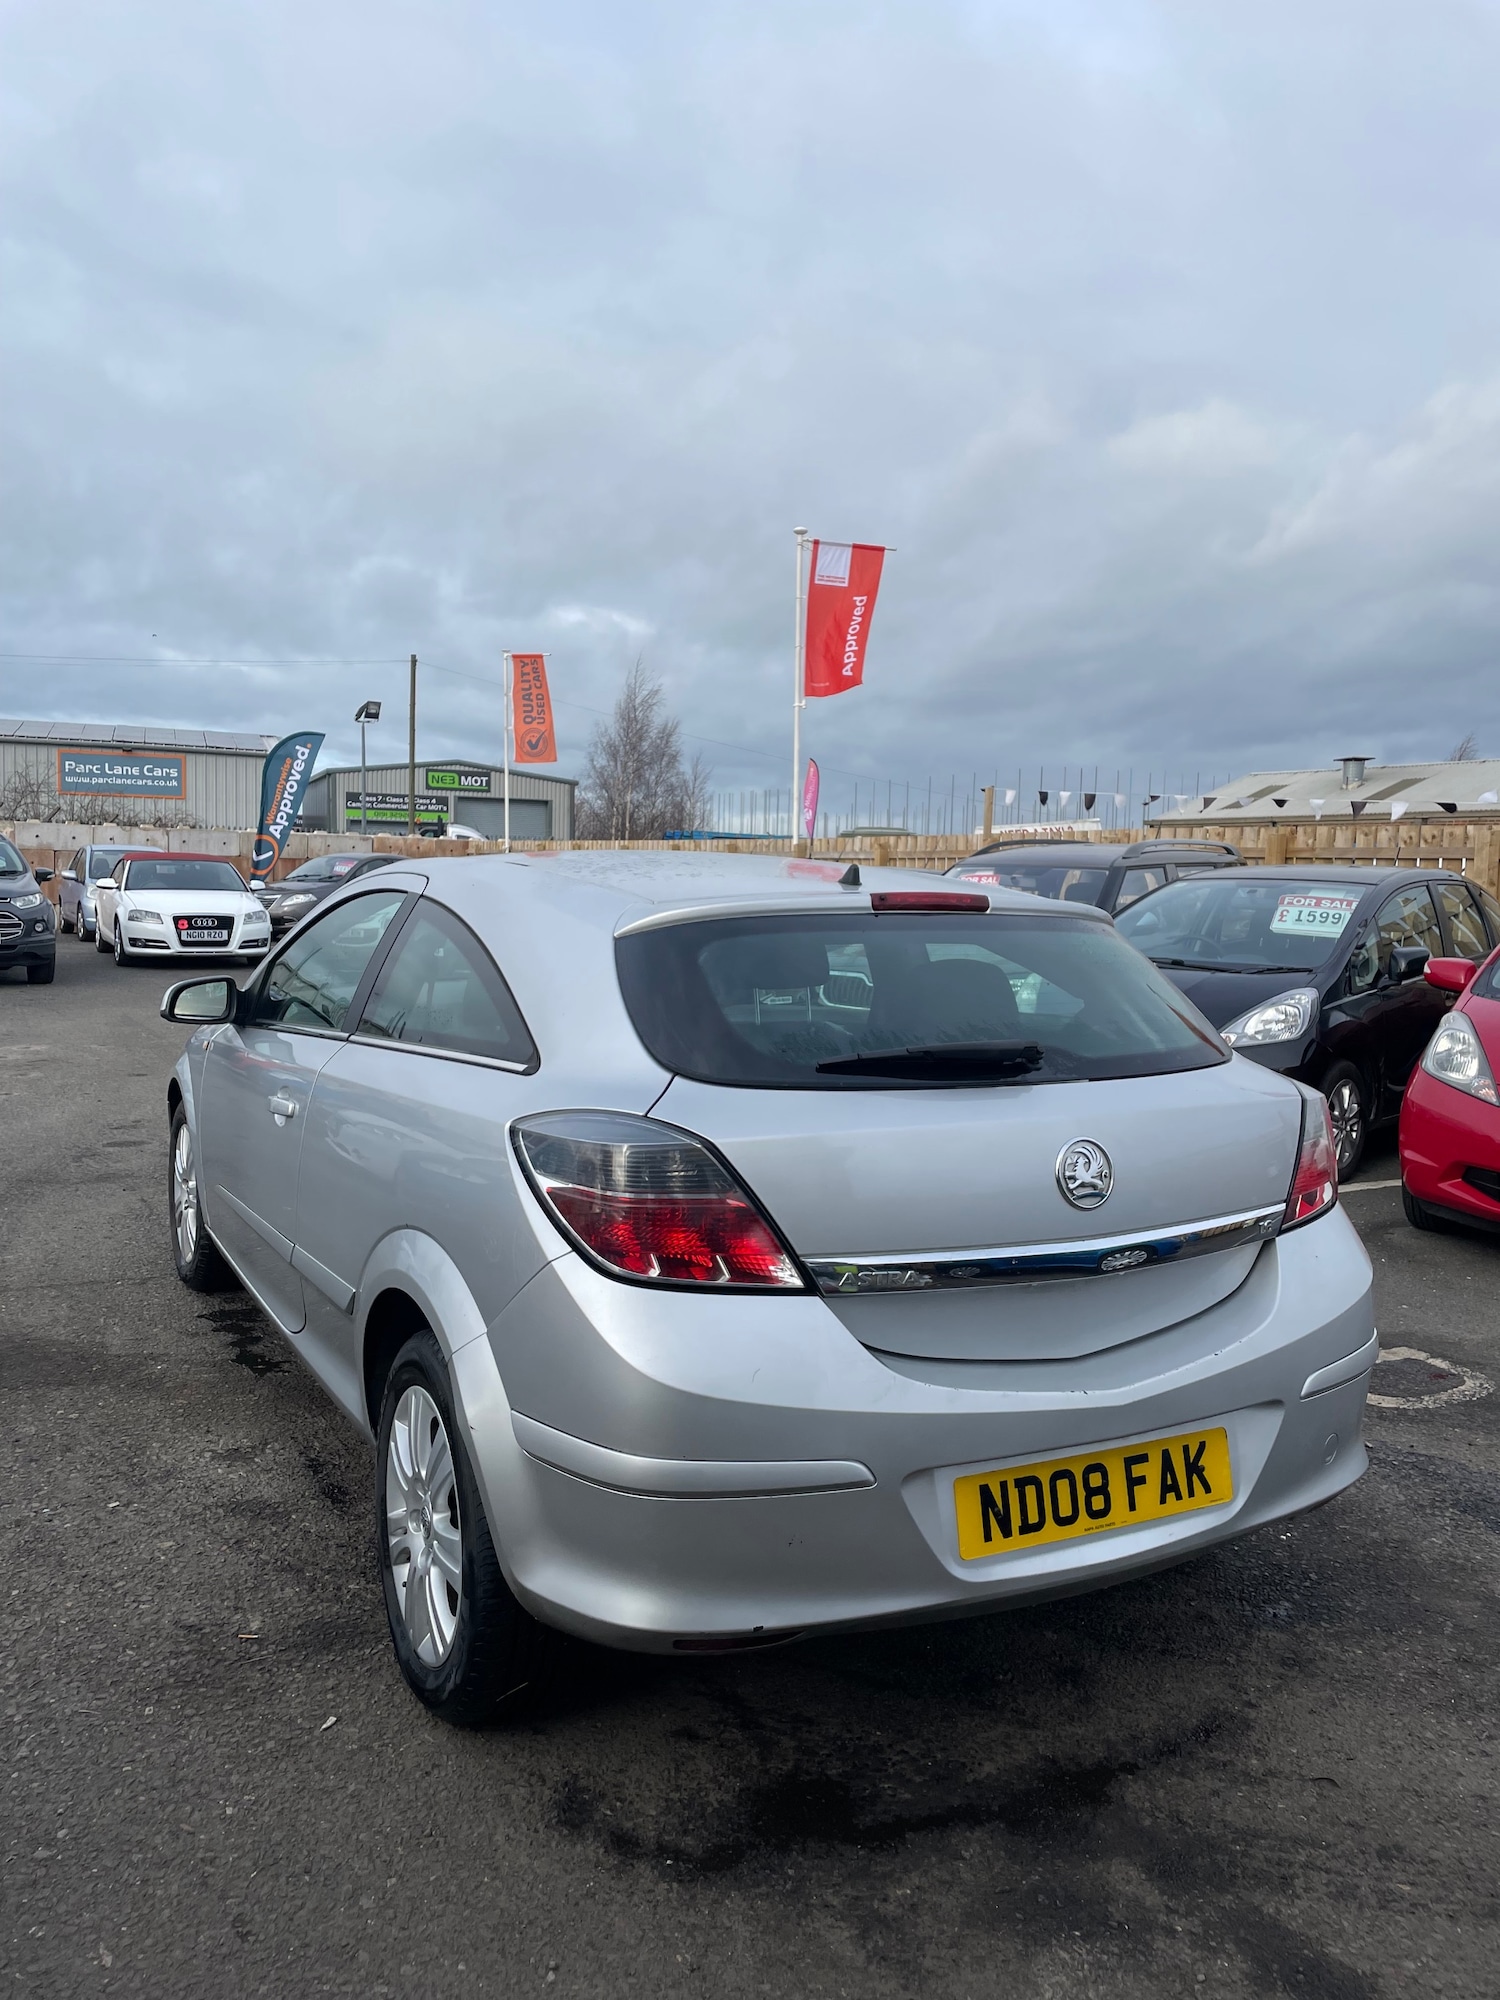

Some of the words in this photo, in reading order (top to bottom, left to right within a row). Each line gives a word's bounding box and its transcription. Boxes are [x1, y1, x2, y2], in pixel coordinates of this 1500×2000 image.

[842, 595, 868, 676] Approved
[530, 658, 543, 690] CARS
[520, 659, 536, 725] QUALITY
[536, 693, 546, 725] USED
[65, 761, 101, 773] Parc
[105, 763, 140, 776] Lane
[143, 765, 178, 777] Cars
[65, 776, 178, 787] www.parclanecars.co.uk
[460, 775, 489, 787] MOT
[265, 757, 293, 824] Warrantywise
[359, 794, 376, 802] Cass
[1283, 896, 1317, 907] FOR
[1320, 899, 1359, 910] SALE
[186, 931, 205, 939] NG10
[839, 1269, 918, 1287] ASTRA
[978, 1462, 1112, 1543] ND08
[1123, 1440, 1212, 1513] FAK
